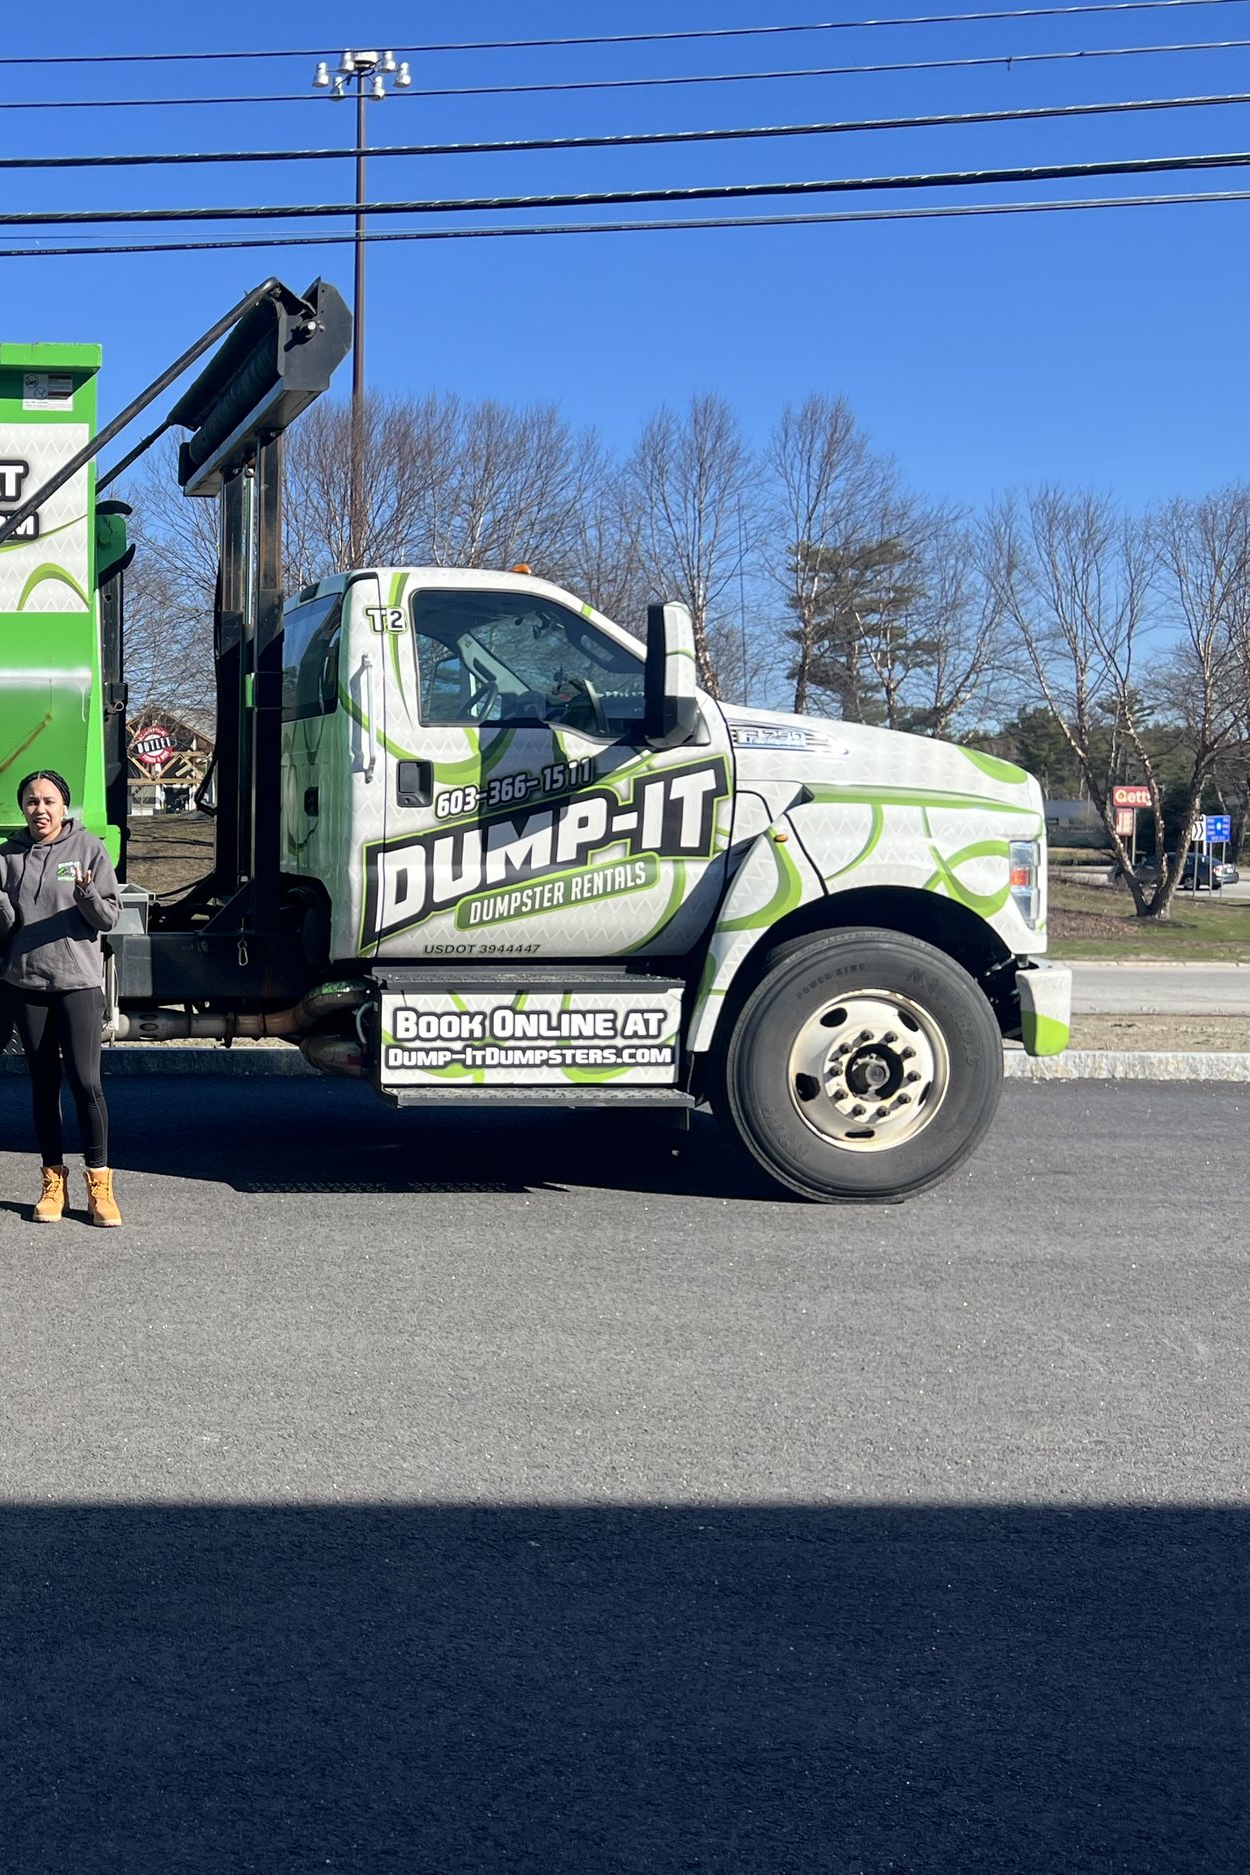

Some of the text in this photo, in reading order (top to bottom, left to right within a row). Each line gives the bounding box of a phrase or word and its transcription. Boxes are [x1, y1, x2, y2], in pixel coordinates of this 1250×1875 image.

[137, 737, 171, 754] OUTLET
[436, 758, 591, 818] 603-366-1511
[375, 768, 717, 933] DUMP-IT
[469, 861, 646, 925] DUMPSTER RENTALS
[424, 944, 541, 954] USDOT 3944447
[396, 1009, 664, 1040] BOOK ONLINE AT
